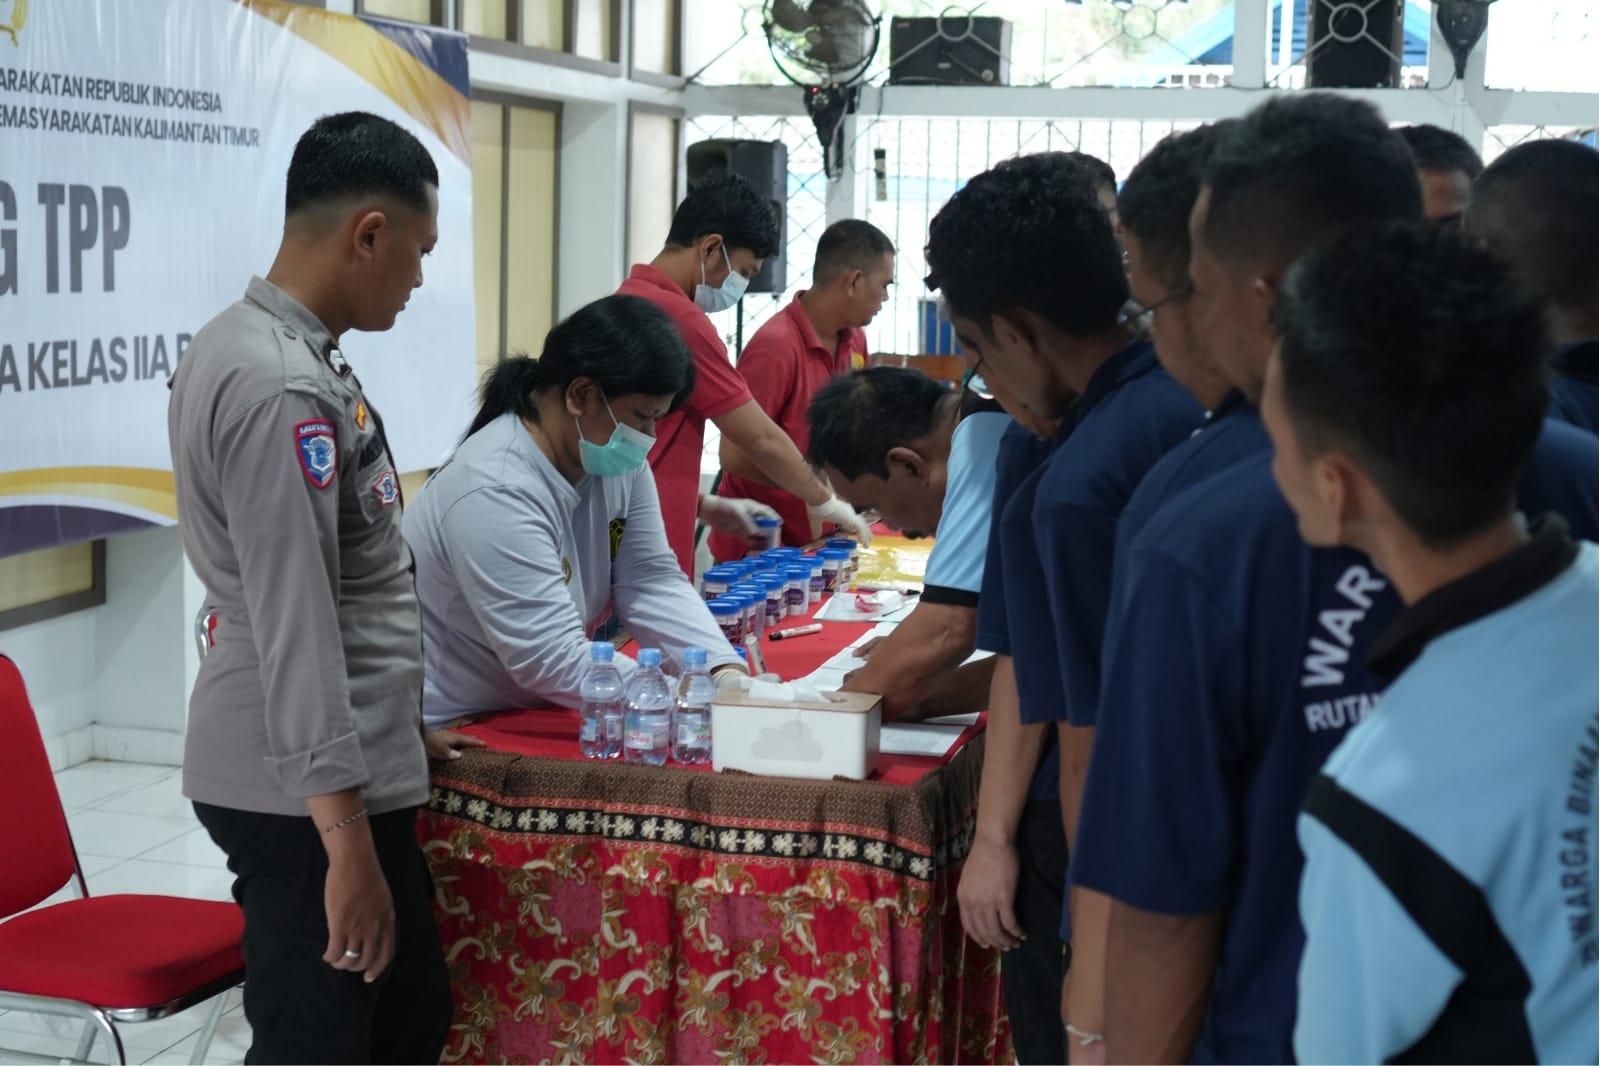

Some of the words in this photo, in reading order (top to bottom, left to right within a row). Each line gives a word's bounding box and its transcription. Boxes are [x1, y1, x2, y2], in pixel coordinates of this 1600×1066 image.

[85, 77, 150, 106] REPUBLIK
[152, 85, 222, 113] INDONESIA
[134, 116, 220, 144] KALIMANTAN
[222, 125, 260, 148] TIMUR
[37, 182, 131, 294] TPP
[27, 336, 128, 391] KELAS
[133, 334, 172, 381] IIA
